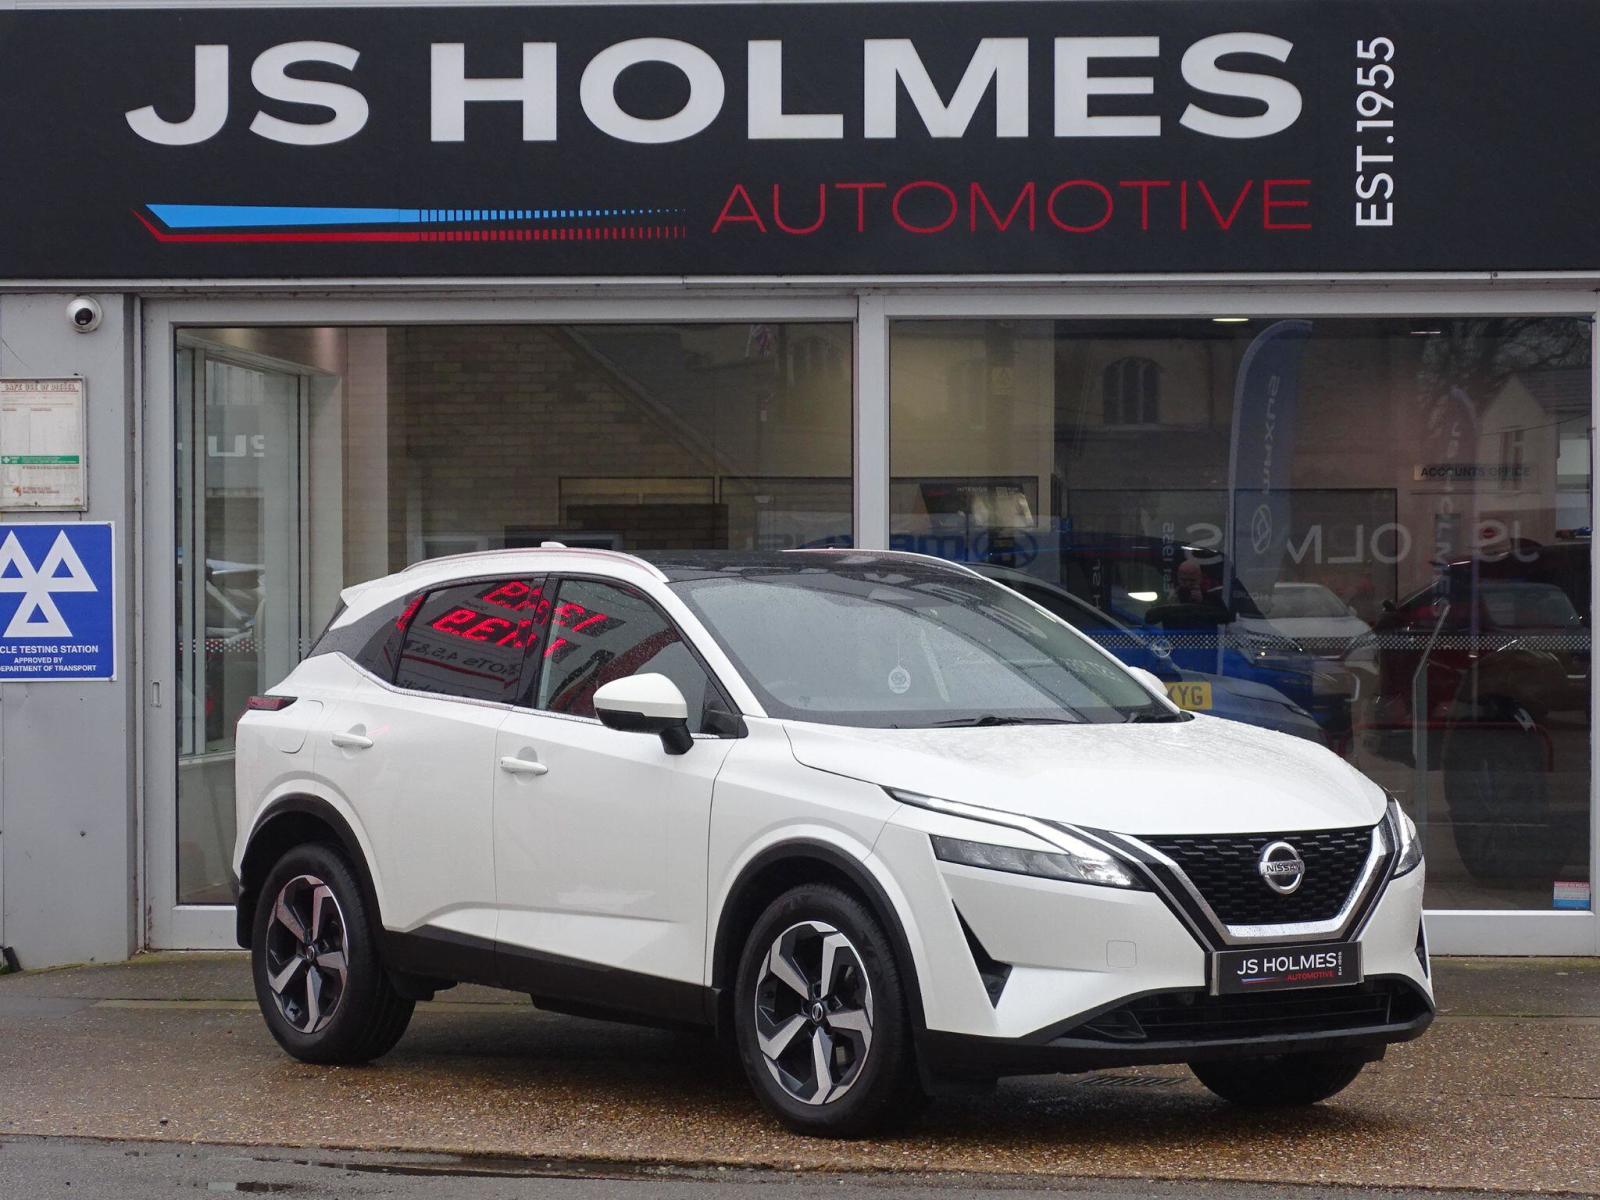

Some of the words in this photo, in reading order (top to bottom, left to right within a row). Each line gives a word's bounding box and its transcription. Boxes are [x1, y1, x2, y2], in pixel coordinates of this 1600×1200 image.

[126, 41, 368, 145] JS
[431, 33, 1302, 143] HOLMES
[711, 179, 1312, 236] AUTOMOTIVE
[19, 645, 58, 654] TESTING
[60, 644, 99, 654] STATION
[53, 656, 63, 664] BY
[55, 664, 97, 672] TRANSPORT
[1266, 864, 1301, 873] NISSAN
[1236, 959, 1259, 975] JS
[1263, 952, 1337, 972] HOLMES
[1287, 970, 1335, 981] AUTOMOTIVE
